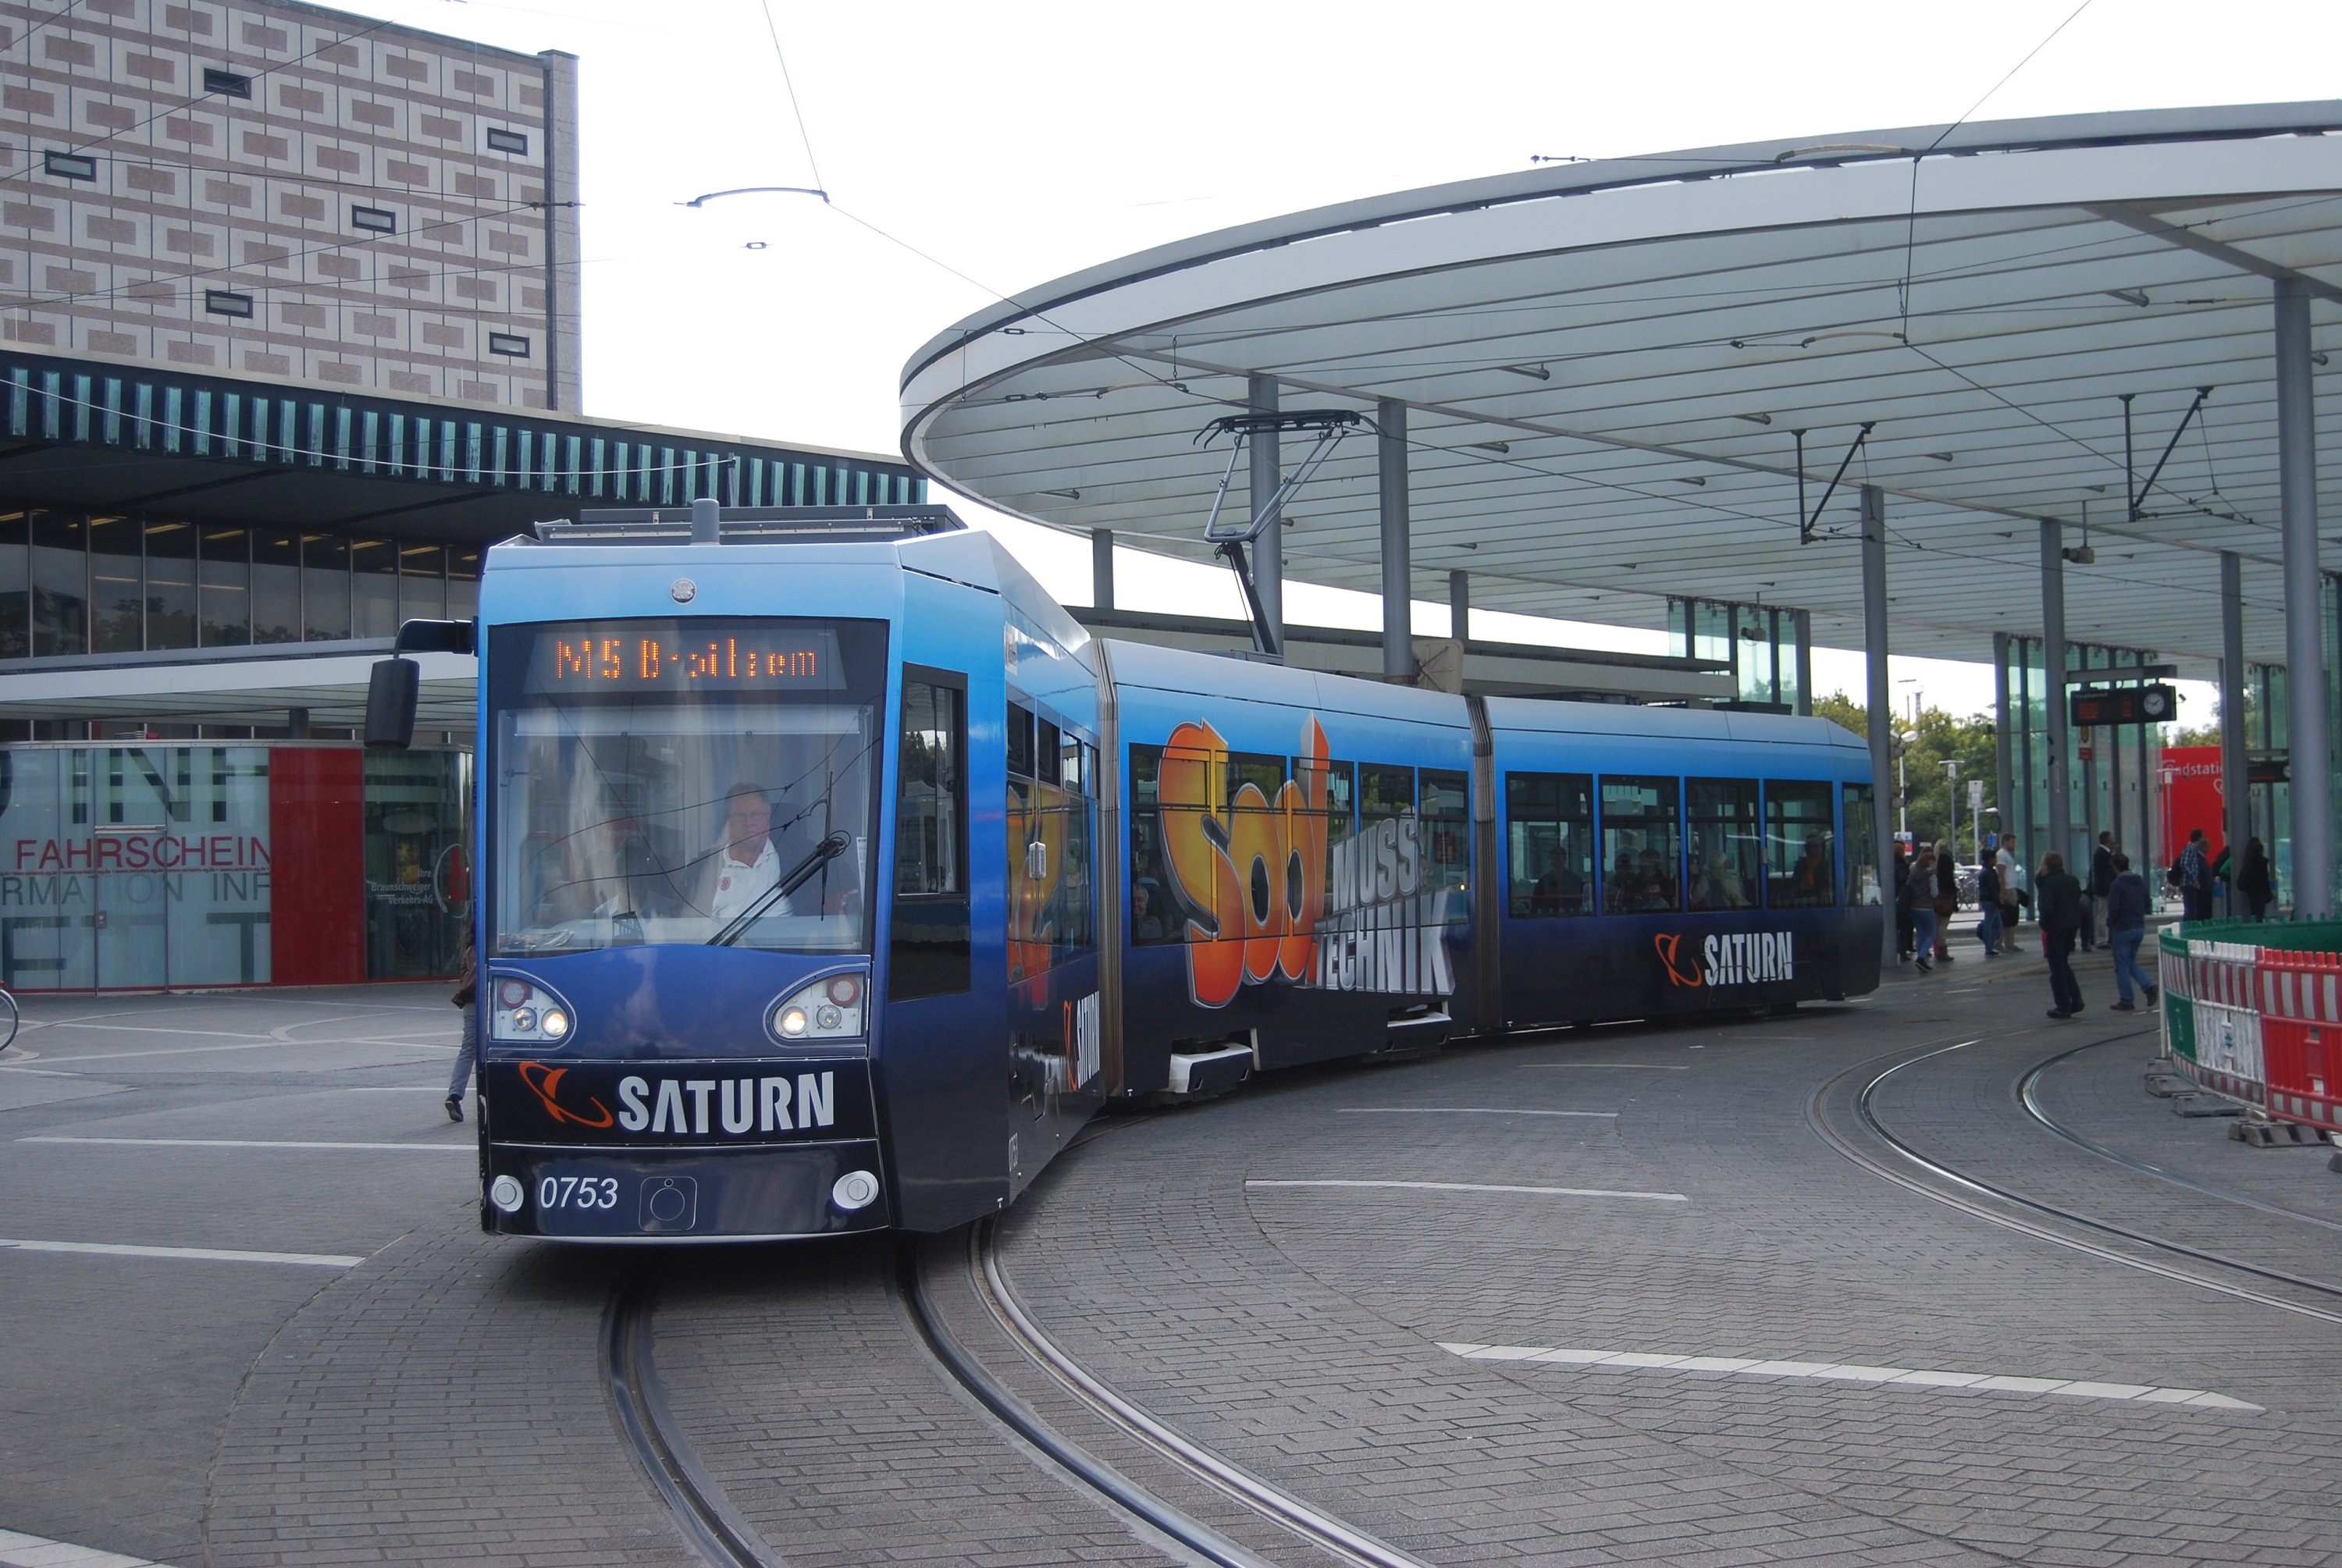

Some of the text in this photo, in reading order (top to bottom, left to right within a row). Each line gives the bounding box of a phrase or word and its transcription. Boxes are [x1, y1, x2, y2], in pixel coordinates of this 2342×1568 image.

[557, 640, 621, 679] M5
[16, 836, 270, 869] FAHRSCHEIN
[1333, 805, 1423, 914] MUSS
[1315, 887, 1456, 996] TECHNIK
[1703, 931, 1793, 987] SATURN
[618, 1070, 835, 1134] SATURN
[540, 1175, 618, 1209] 0753
